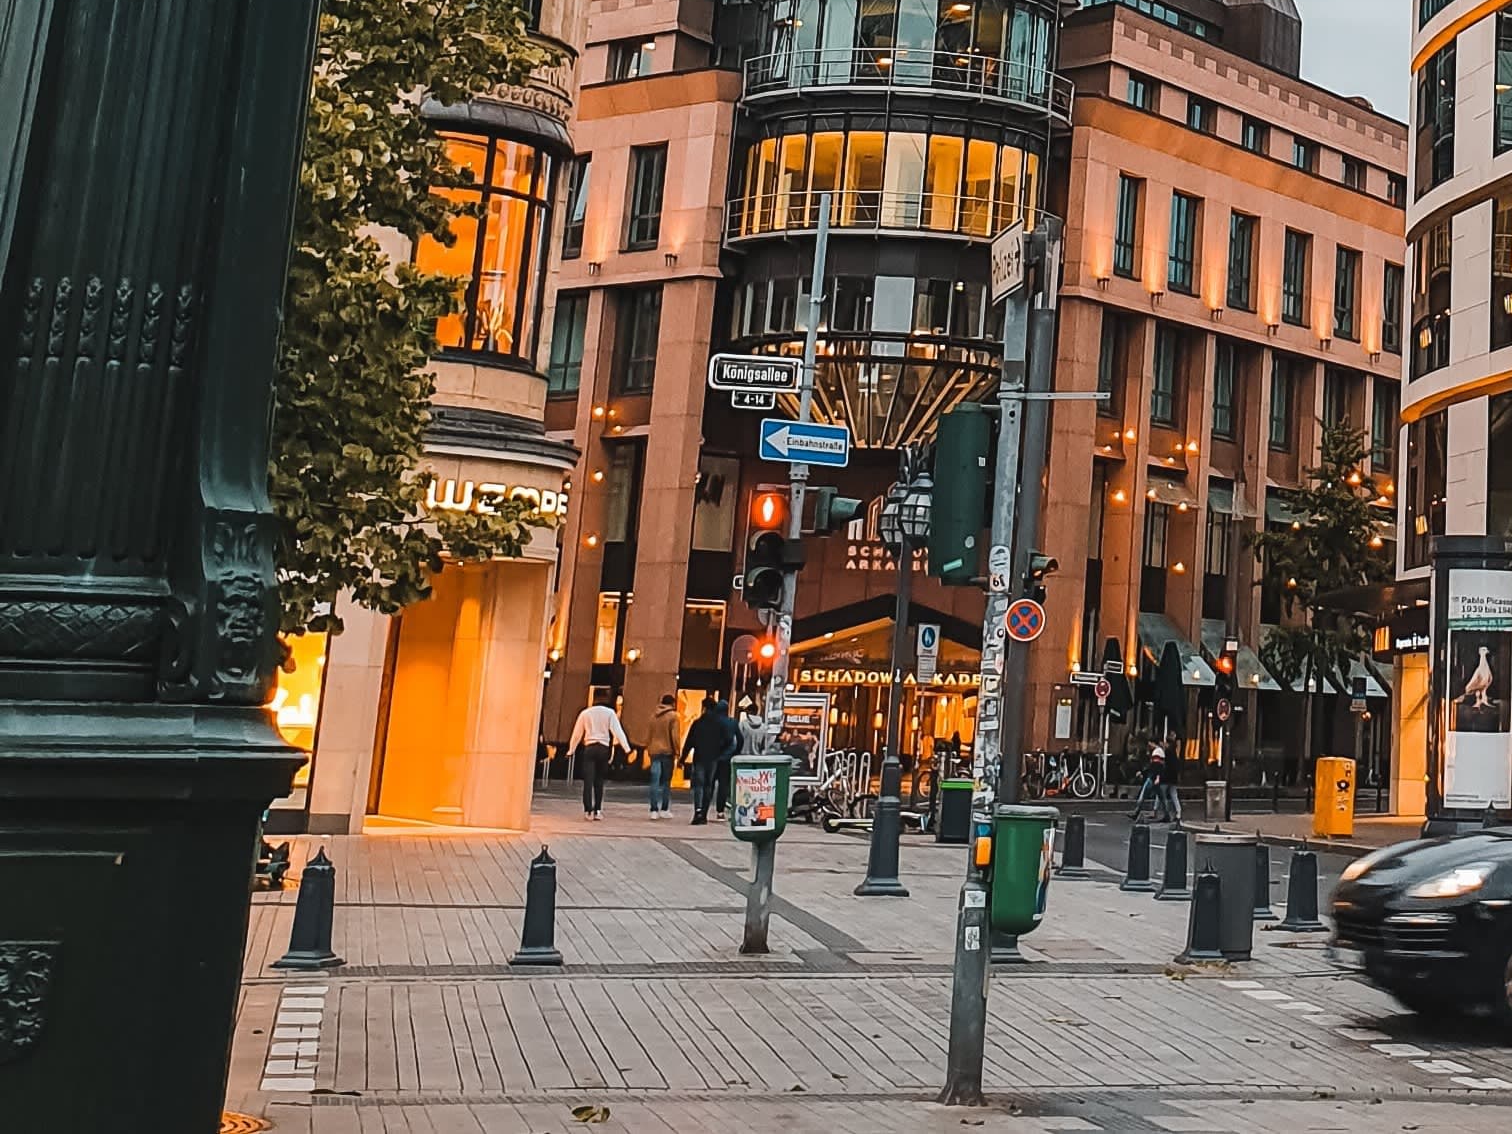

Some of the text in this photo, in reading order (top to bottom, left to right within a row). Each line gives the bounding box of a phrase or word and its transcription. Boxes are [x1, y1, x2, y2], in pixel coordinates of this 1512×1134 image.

[722, 364, 788, 383] Königsallee
[744, 394, 765, 405] 4-14
[786, 437, 843, 451] Einbahnstraße
[800, 669, 893, 684] SCHADOW
